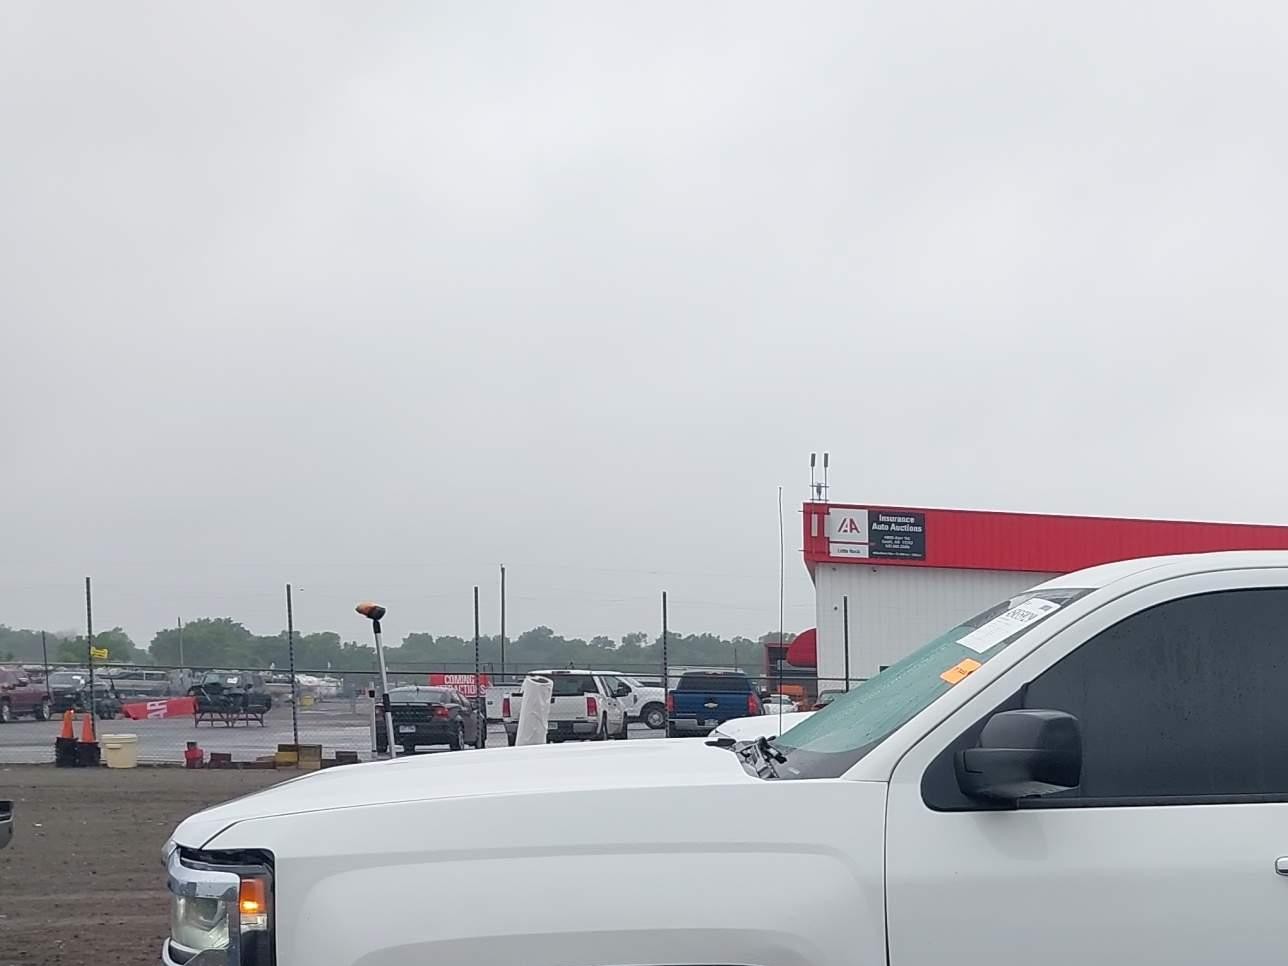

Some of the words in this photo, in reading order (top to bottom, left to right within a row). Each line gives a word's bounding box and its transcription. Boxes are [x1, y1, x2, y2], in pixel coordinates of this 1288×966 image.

[879, 513, 915, 523] Insurance
[871, 522, 889, 531] Auto
[890, 523, 922, 532] Auctions
[444, 675, 475, 684] COMING
